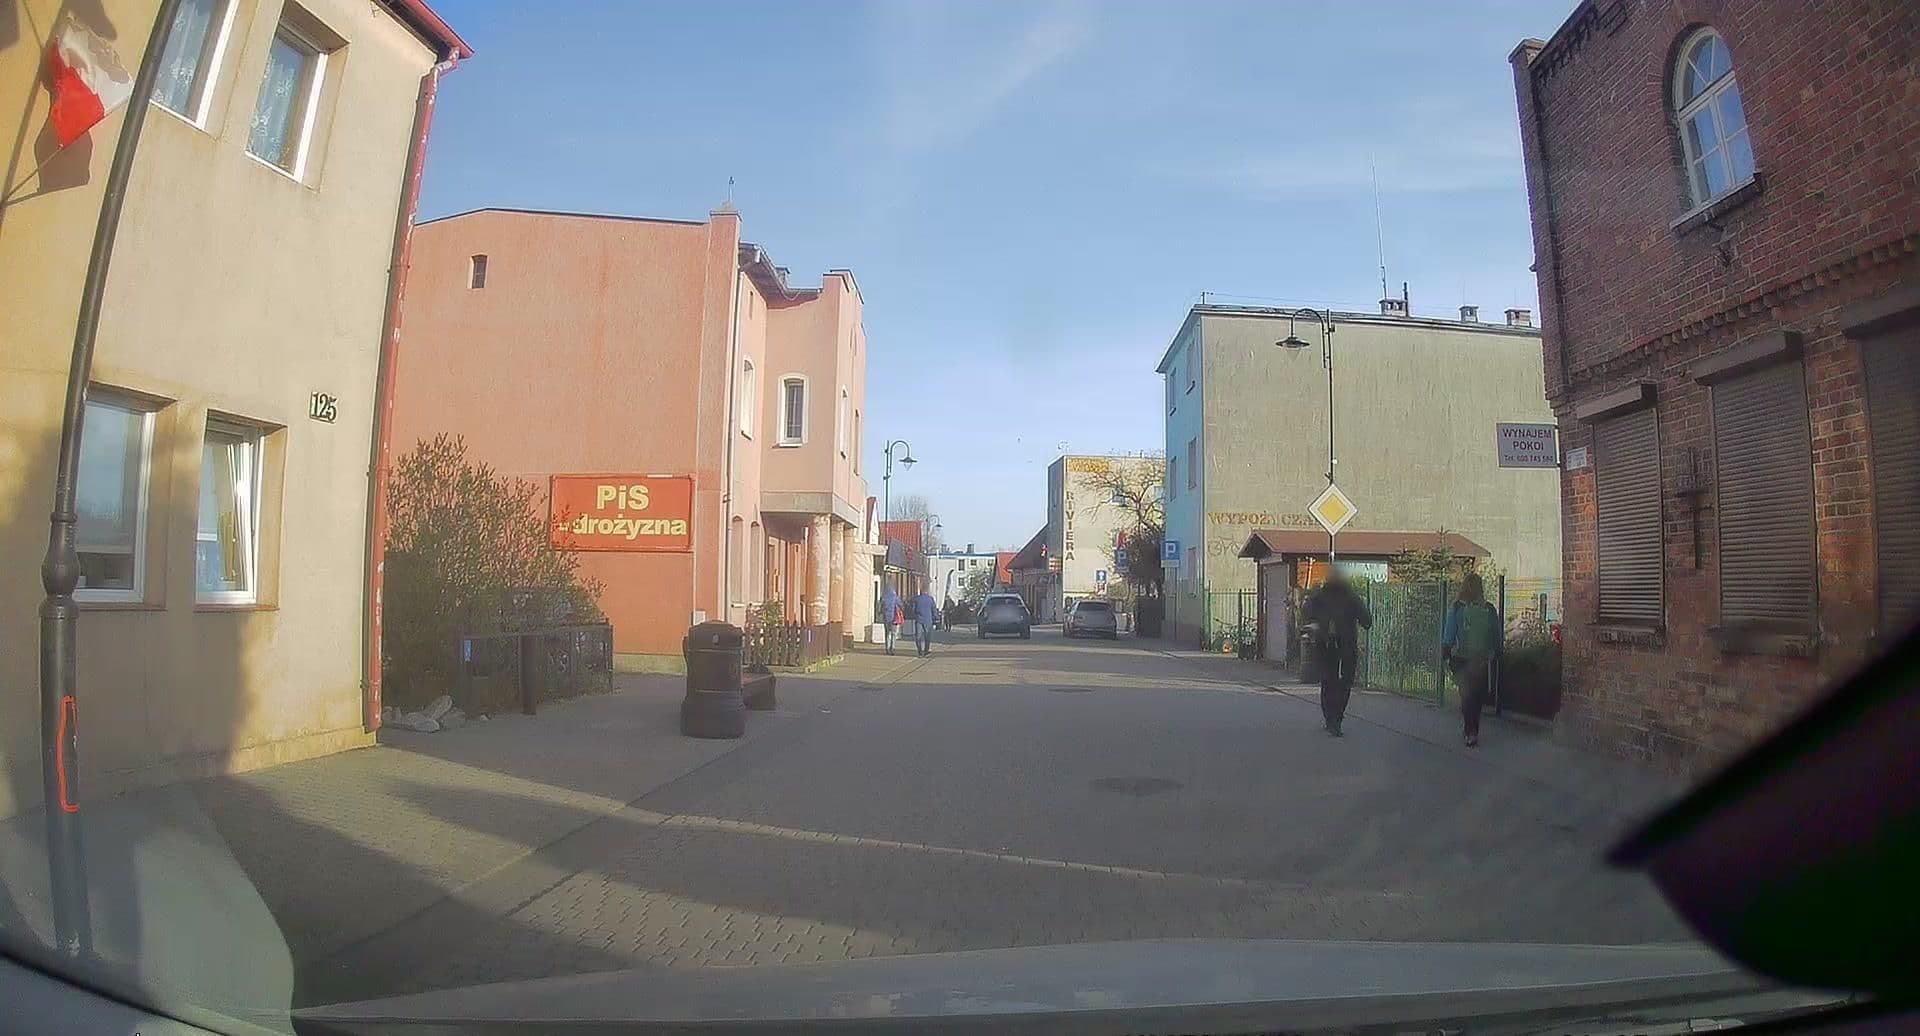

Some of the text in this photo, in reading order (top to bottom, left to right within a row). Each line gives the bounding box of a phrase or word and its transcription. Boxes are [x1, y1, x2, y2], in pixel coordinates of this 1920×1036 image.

[311, 393, 337, 421] 125
[1502, 428, 1552, 439] WYNAJEM
[1513, 441, 1544, 451] POKOI
[597, 485, 649, 510] PiS
[1066, 491, 1074, 560] RIVIERA
